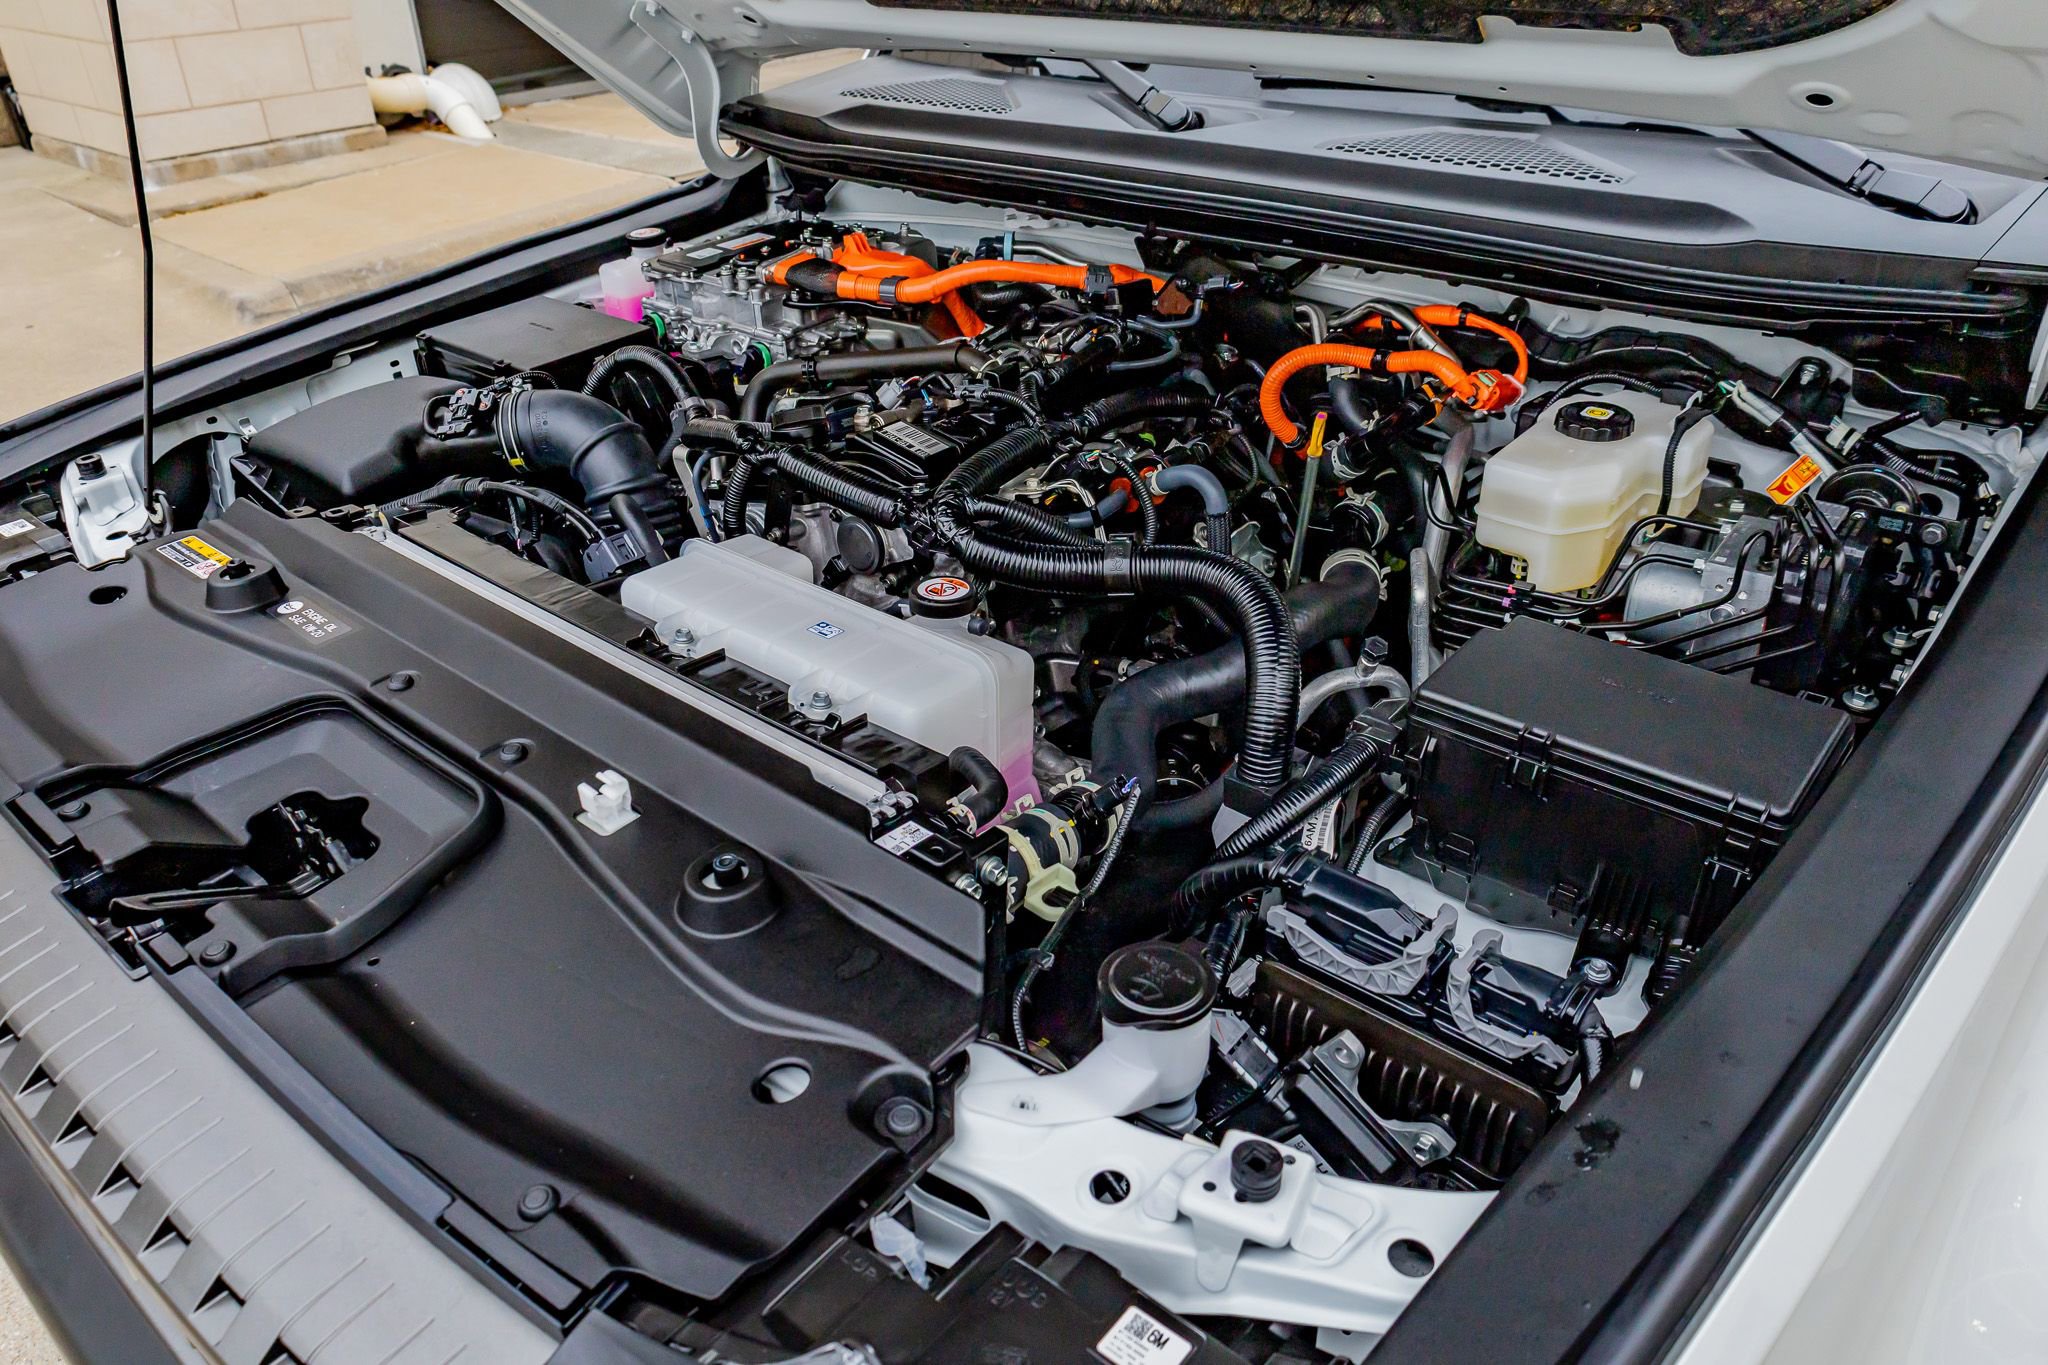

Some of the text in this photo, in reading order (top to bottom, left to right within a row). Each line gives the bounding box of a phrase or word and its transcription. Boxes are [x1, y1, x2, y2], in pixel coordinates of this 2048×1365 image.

[288, 614, 307, 625] SAE
[301, 608, 338, 633] ENGINE OIL
[1146, 1328, 1171, 1351] 6M
